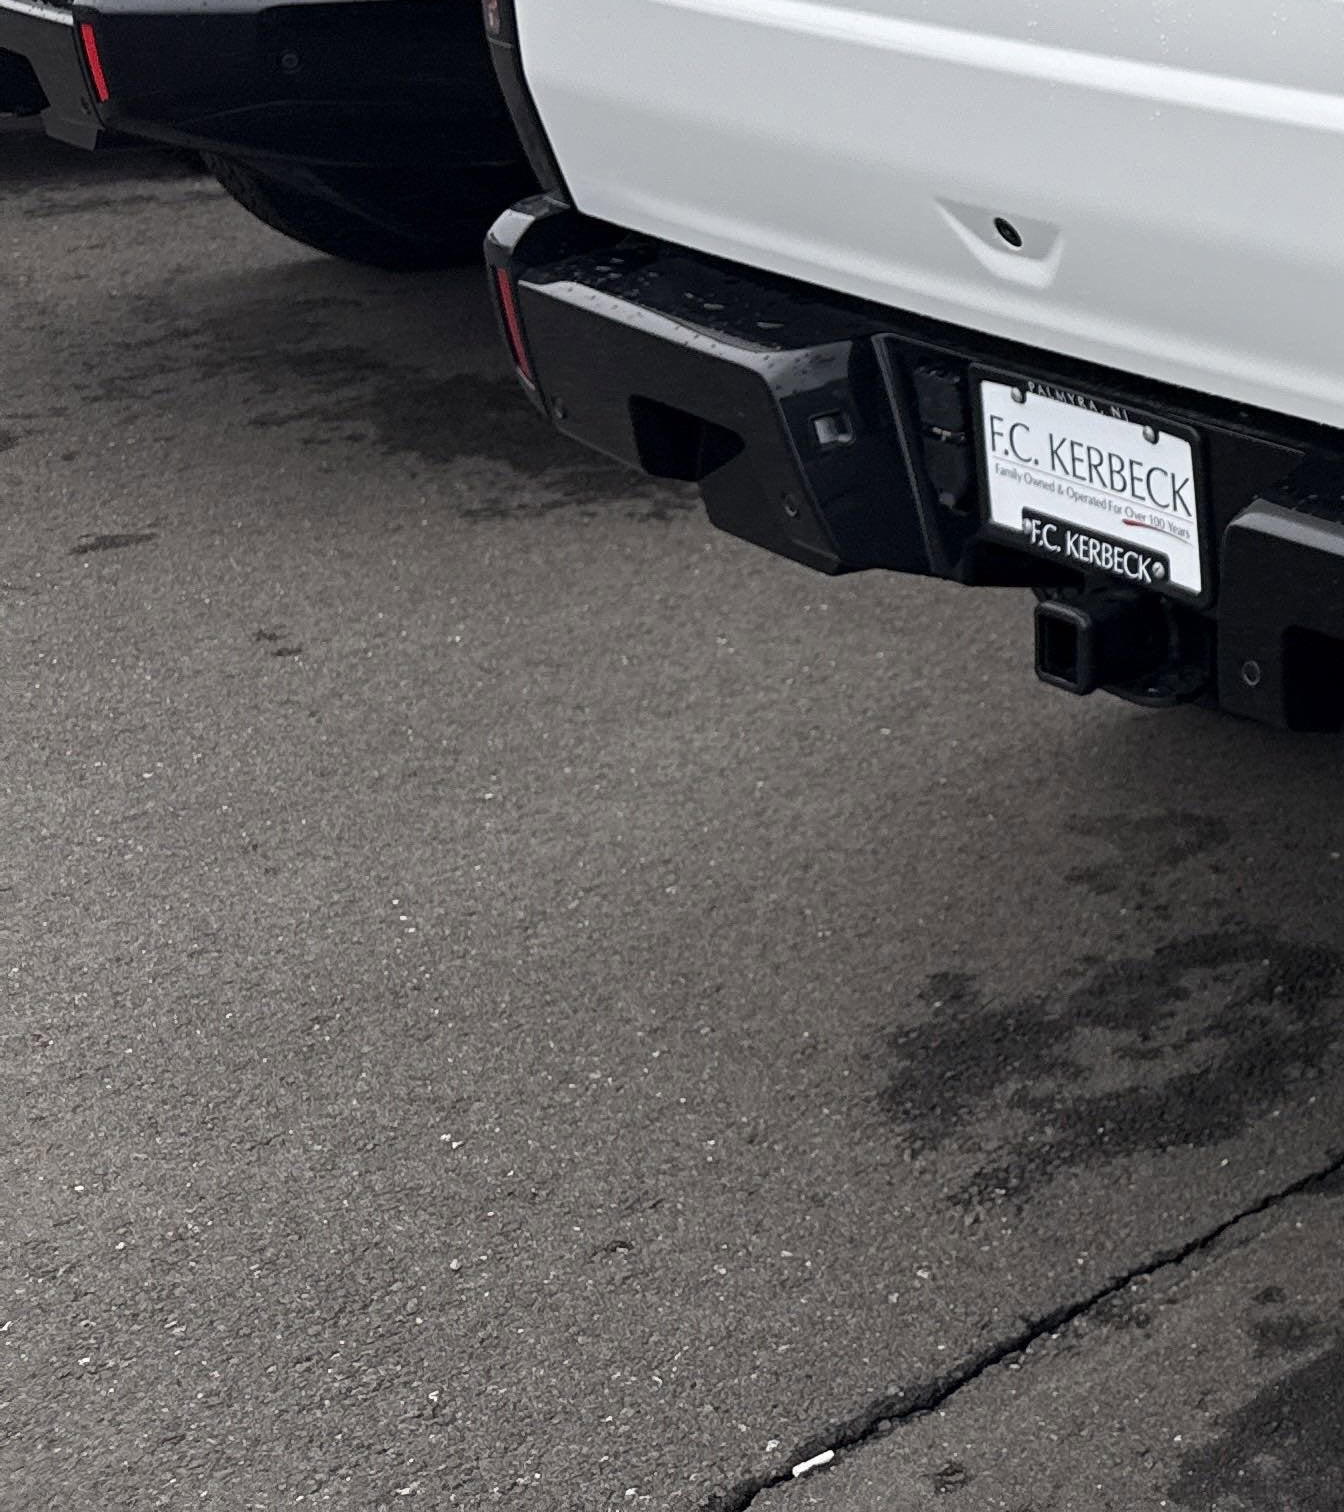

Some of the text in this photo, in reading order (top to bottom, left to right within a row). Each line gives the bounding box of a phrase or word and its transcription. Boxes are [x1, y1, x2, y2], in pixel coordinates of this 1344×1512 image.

[989, 414, 1193, 518] F.C. KERBECK
[995, 462, 1023, 483] Family
[1024, 471, 1056, 494] Owned
[1066, 486, 1107, 511] Operated
[1108, 499, 1123, 516] For
[1124, 505, 1147, 522] Over
[1149, 514, 1166, 529] 100
[1167, 518, 1192, 539] Years
[1030, 518, 1152, 584] F.C. KERBECK
